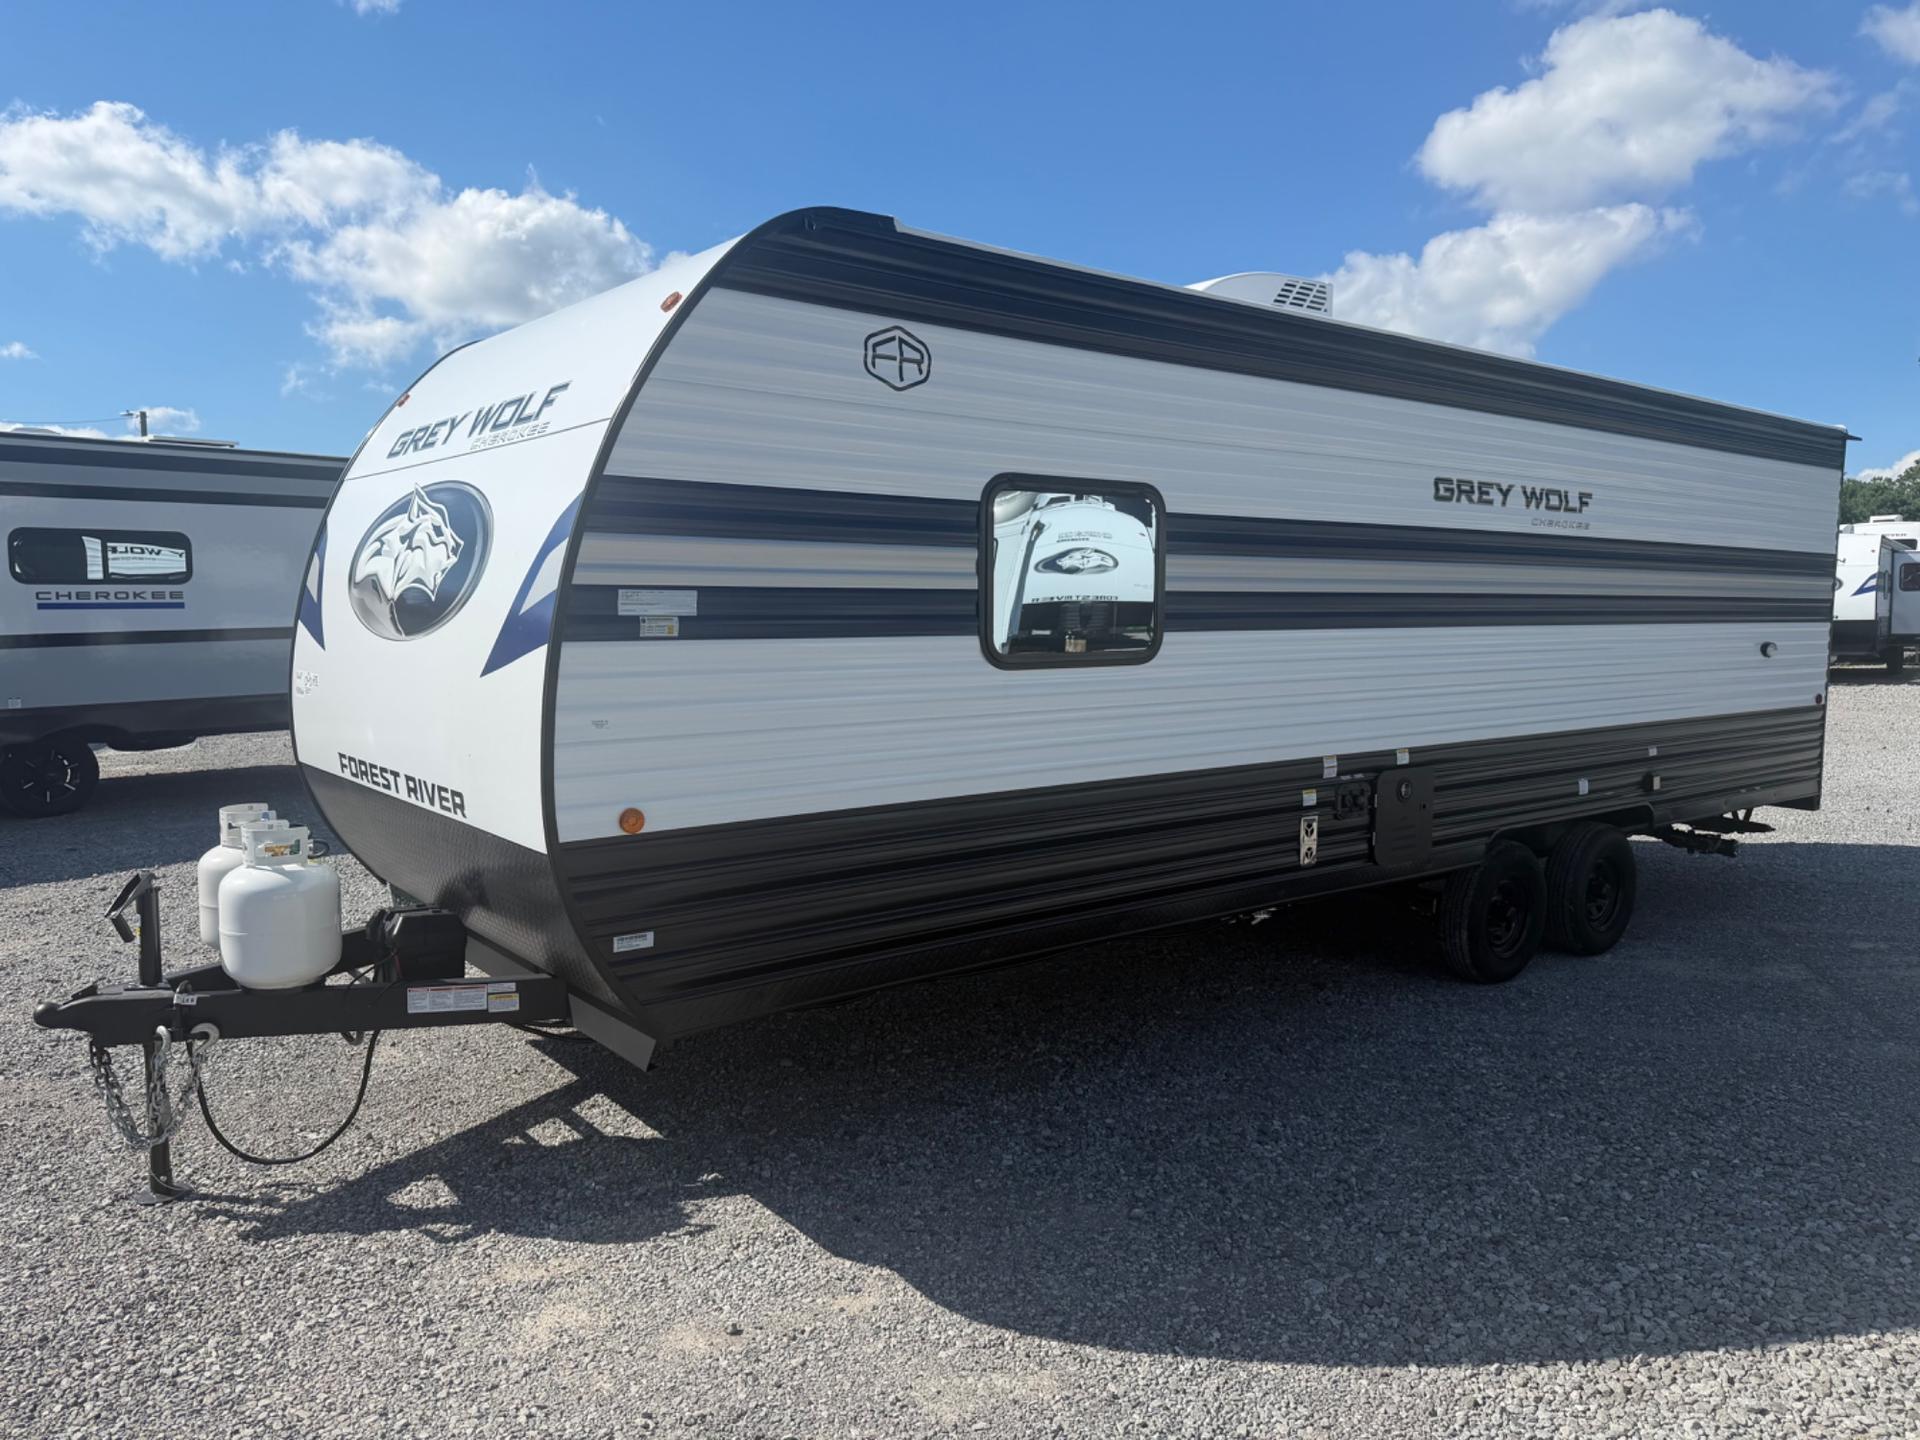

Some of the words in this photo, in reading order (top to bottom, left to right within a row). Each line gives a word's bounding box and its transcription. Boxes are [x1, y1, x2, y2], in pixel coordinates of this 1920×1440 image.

[386, 410, 474, 460] GREY
[467, 380, 573, 438] WOLF
[1433, 476, 1515, 507] GREY
[1521, 485, 1593, 513] WOLF
[35, 590, 184, 601] CHEROKEE
[337, 752, 400, 794] FOREST
[404, 774, 467, 819] RIVER
